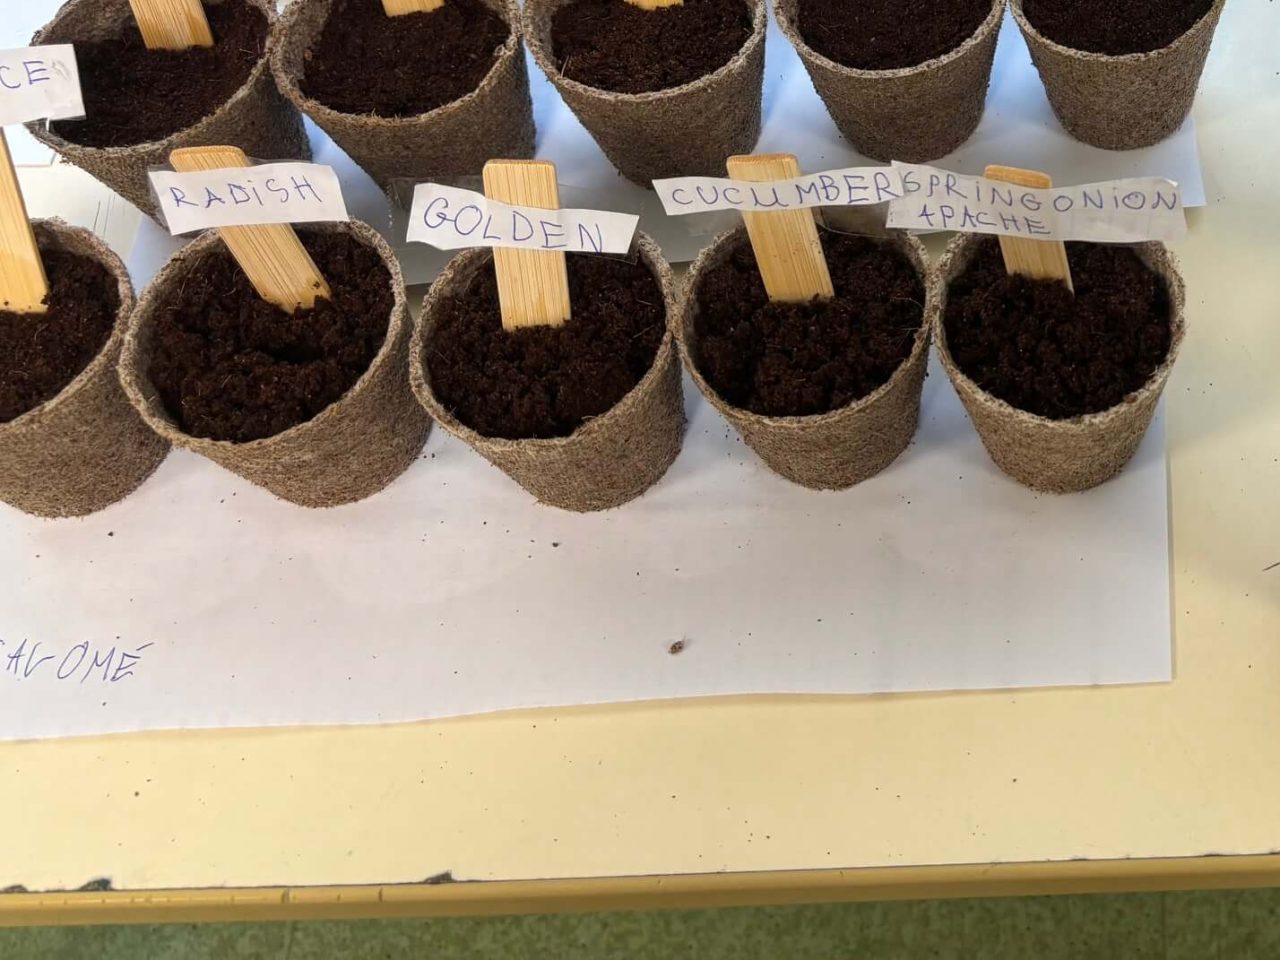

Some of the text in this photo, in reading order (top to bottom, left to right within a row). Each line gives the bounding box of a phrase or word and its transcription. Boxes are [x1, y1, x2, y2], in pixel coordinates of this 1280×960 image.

[672, 171, 901, 207] CUCUMBER
[424, 194, 604, 255] GOLDEN
[918, 203, 1051, 235] APACHE
